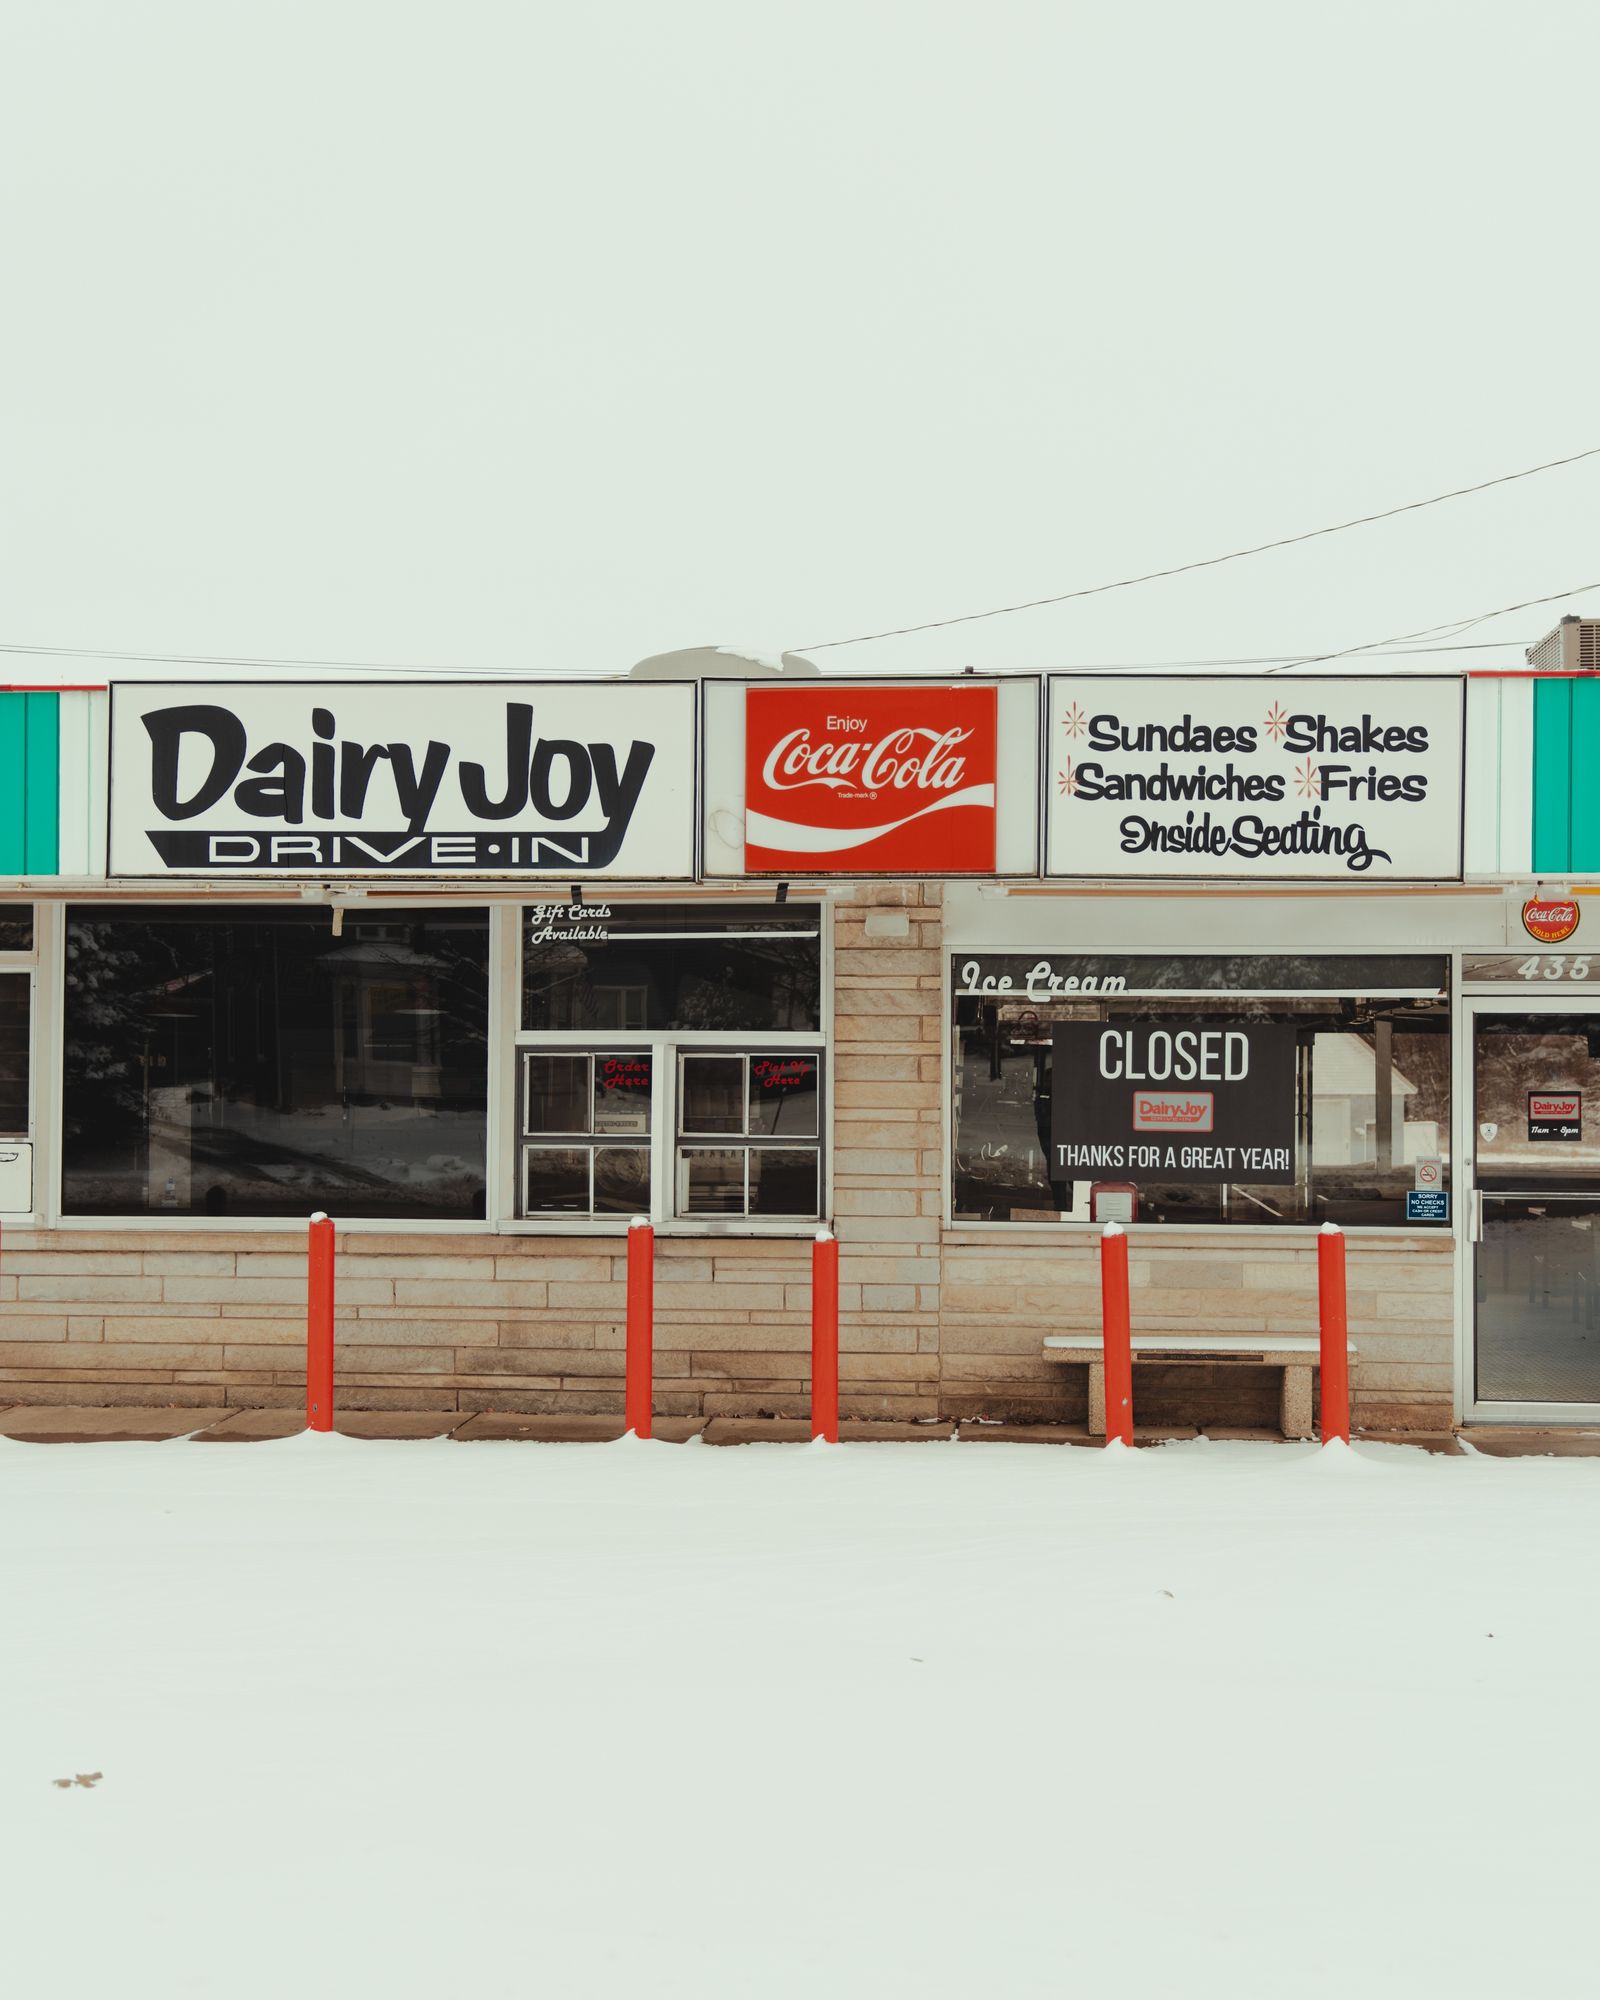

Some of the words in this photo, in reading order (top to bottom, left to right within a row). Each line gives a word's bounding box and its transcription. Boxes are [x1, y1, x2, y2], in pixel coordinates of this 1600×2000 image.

[827, 716, 867, 732] Enjoy
[1088, 714, 1257, 753] Sundaes
[1283, 714, 1429, 754] Shakes
[140, 704, 450, 831] Dairy
[458, 702, 655, 832] Joy
[763, 727, 975, 790] Coca-Cola
[1073, 762, 1285, 801] Sandwiches
[1318, 765, 1428, 802] Fries
[1120, 810, 1232, 856] Inside
[1229, 805, 1392, 871] Seating
[531, 904, 564, 925] Gift
[568, 904, 611, 919] Cards
[1526, 906, 1574, 922] Coca-Cola
[531, 926, 608, 944] Available
[1532, 926, 1550, 938] SOLD
[1551, 925, 1571, 938] HERE
[1517, 956, 1592, 980] 435
[962, 961, 1013, 994] Ice
[1025, 961, 1126, 1002] Cream
[1100, 1030, 1249, 1080] CLOSED
[603, 1058, 649, 1074] Order
[603, 1074, 649, 1089] Here
[763, 1073, 800, 1088] Here
[1139, 1100, 1181, 1116] Dairy
[1180, 1101, 1208, 1117] Joy
[1533, 1101, 1559, 1112] Dairy
[1559, 1101, 1576, 1112] Joy
[1531, 1126, 1549, 1134] 11am
[1560, 1126, 1579, 1137] 8pm
[1057, 1144, 1124, 1168] THANKS
[1129, 1145, 1159, 1168] FOR
[1165, 1146, 1176, 1169] A
[1181, 1146, 1235, 1169] GREAT
[1240, 1147, 1289, 1170] YEAR!
